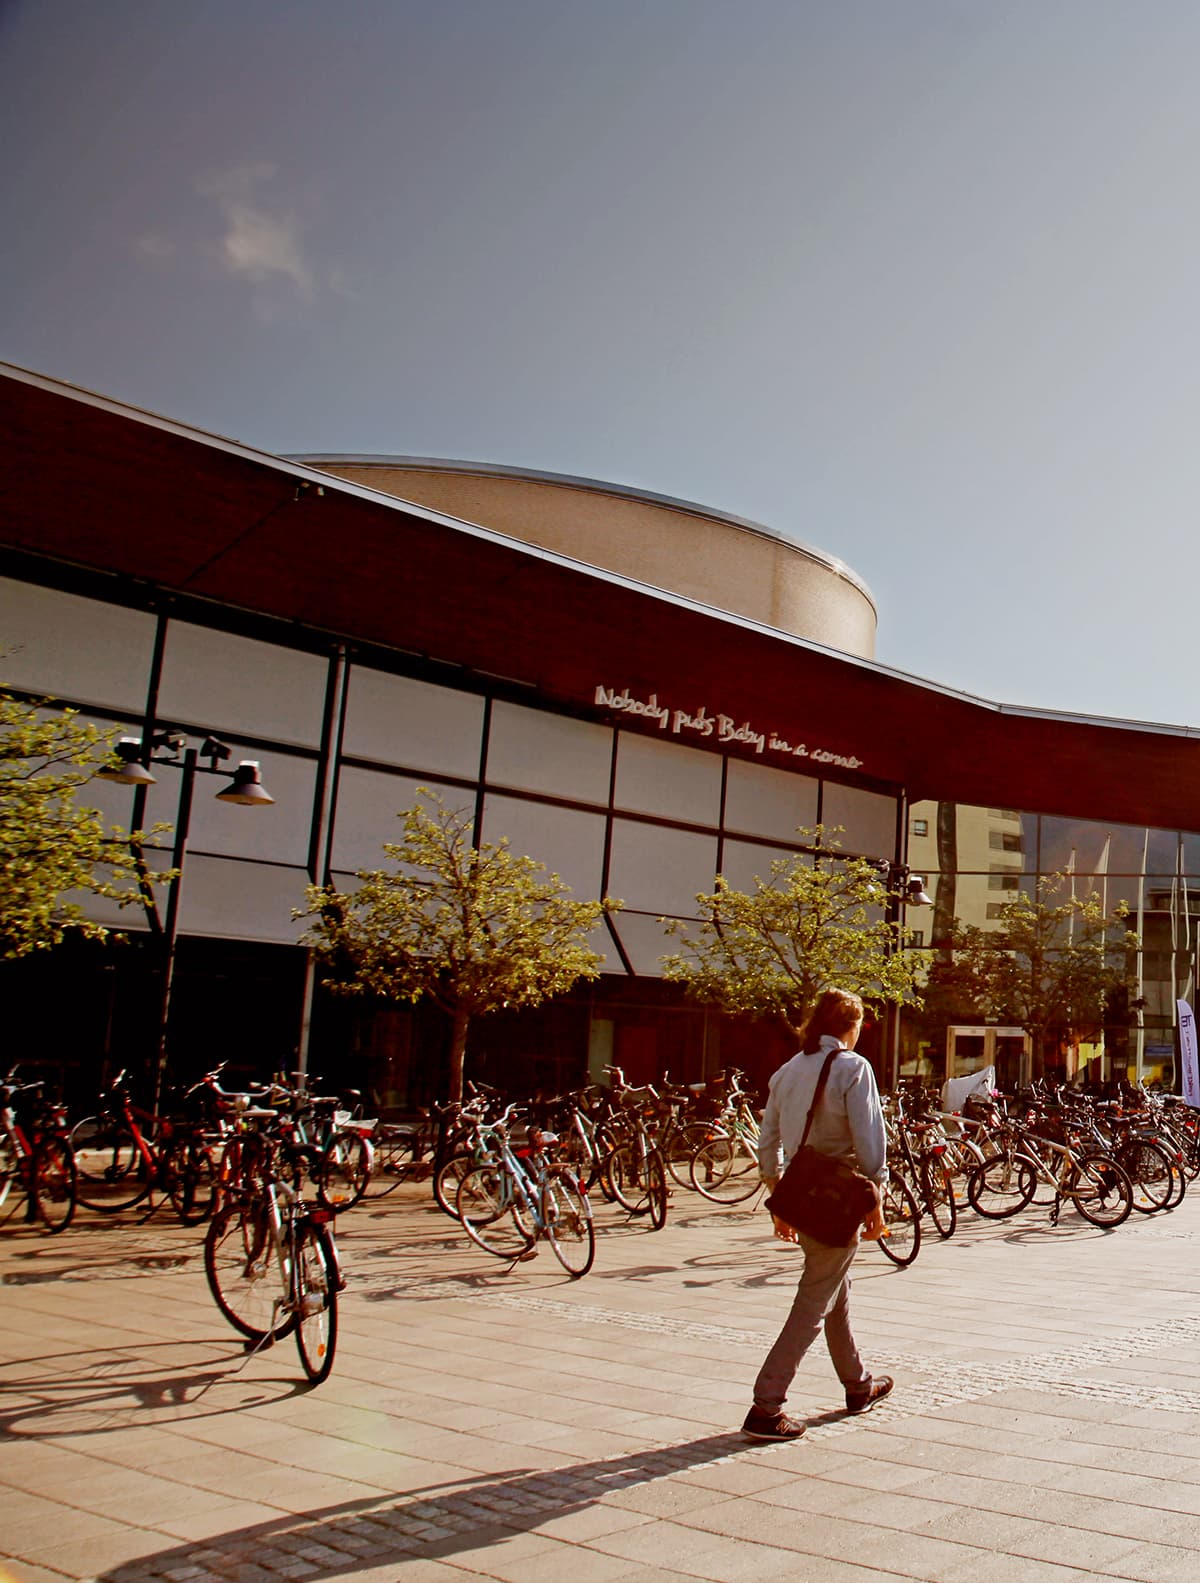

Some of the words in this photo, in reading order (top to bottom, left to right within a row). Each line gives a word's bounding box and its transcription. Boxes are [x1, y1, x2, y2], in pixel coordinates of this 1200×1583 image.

[595, 685, 669, 729] Nobody
[672, 706, 715, 736] puts
[716, 713, 765, 753] Baby
[769, 732, 792, 752] in
[793, 743, 809, 756] a
[810, 748, 864, 769] corner
